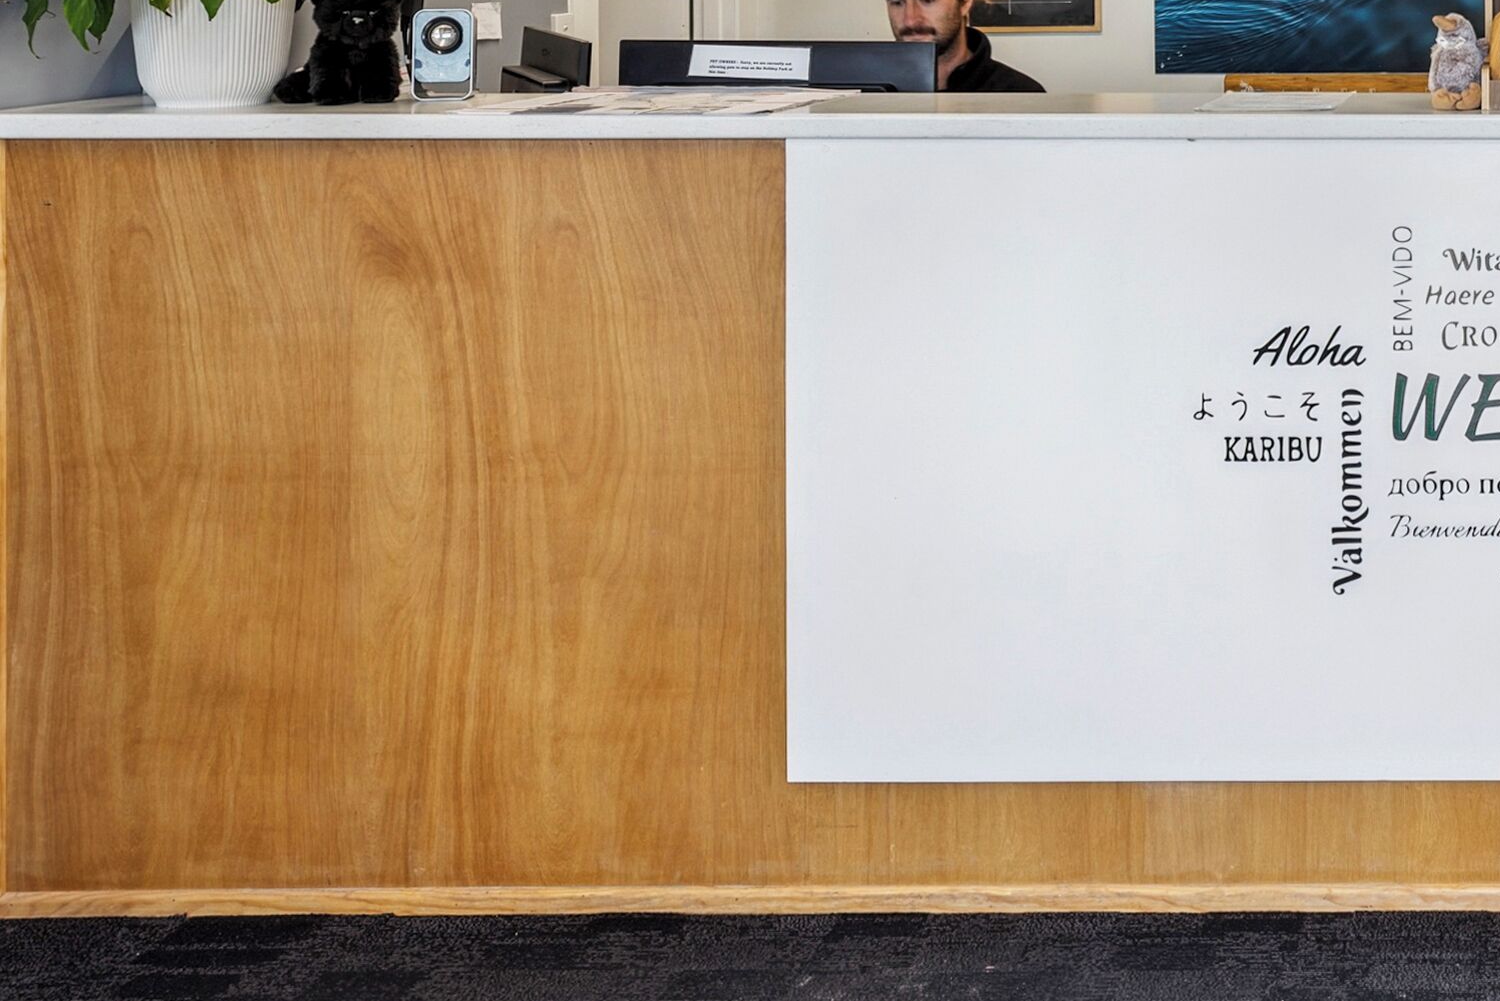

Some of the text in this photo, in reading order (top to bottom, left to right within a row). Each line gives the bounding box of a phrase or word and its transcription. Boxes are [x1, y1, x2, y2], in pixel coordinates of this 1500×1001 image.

[1391, 225, 1414, 352] BEM-VIDO
[1425, 284, 1495, 306] Haere
[1252, 324, 1367, 368] Aloha
[1192, 391, 1321, 423] ようこそ
[1223, 435, 1323, 464] KARIBU
[1330, 388, 1369, 596] Välkommen
[1387, 470, 1471, 502] добро
